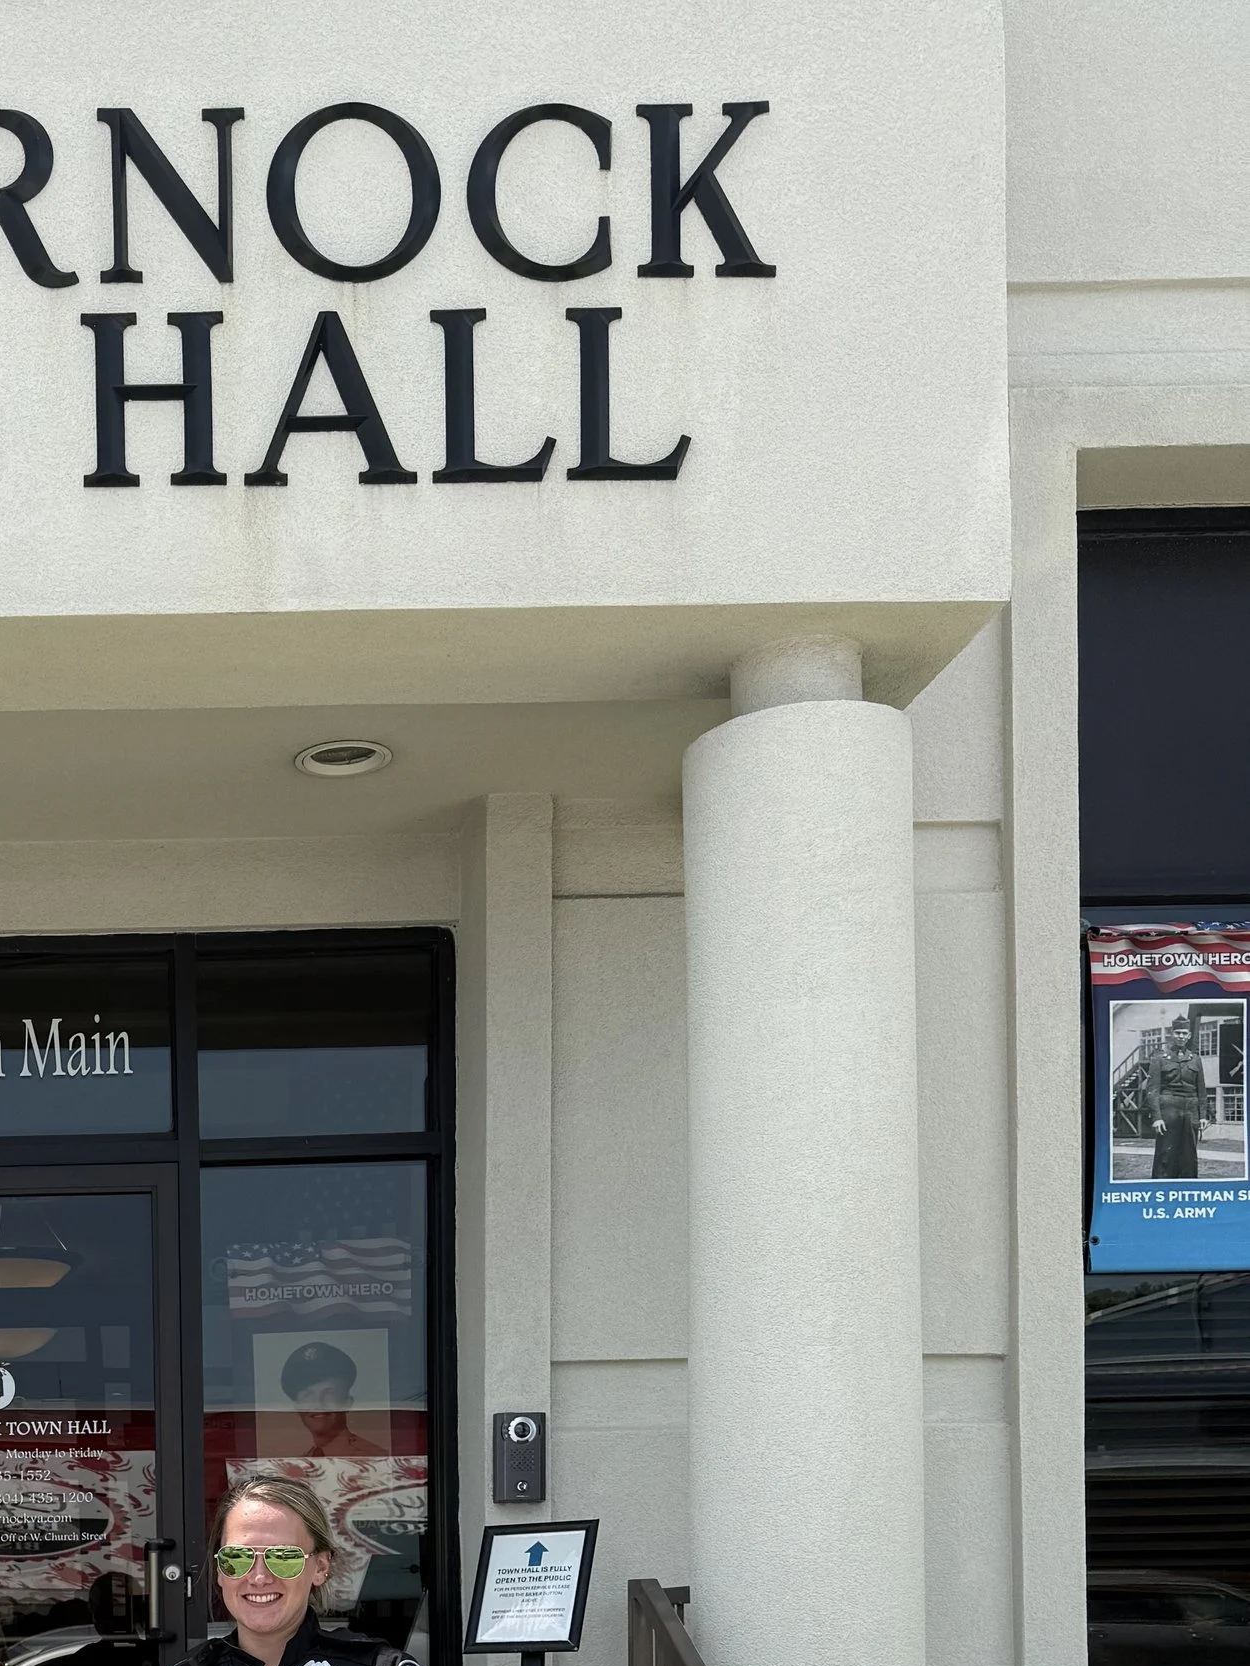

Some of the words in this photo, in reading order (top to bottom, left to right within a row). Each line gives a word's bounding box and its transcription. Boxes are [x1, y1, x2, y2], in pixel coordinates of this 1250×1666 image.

[82, 307, 692, 489] HALL
[1103, 953, 1204, 967] HOMETOWN
[19, 1014, 134, 1080] Main
[1102, 1190, 1152, 1204] HENRY
[1156, 1190, 1165, 1203] S
[1168, 1190, 1235, 1203] PITTMAN
[1237, 1190, 1250, 1202] S
[1142, 1207, 1170, 1220] U.S.
[1173, 1207, 1217, 1220] ARMY
[244, 1283, 344, 1303] HOMETOWN
[348, 1282, 395, 1299] HERO
[5, 1420, 63, 1436] TOWN
[67, 1419, 112, 1435] HALL
[6, 1448, 51, 1462] Monday
[54, 1448, 66, 1458] to
[68, 1447, 104, 1460] Friday
[28, 1491, 94, 1505] 435-1200
[0, 1532, 17, 1543] Off
[17, 1532, 29, 1543] of
[30, 1532, 43, 1542] W.
[44, 1531, 80, 1542] Church
[81, 1530, 108, 1541] Street
[520, 1566, 540, 1574] HALL
[549, 1565, 573, 1573] FULLY
[543, 1574, 572, 1582] PUBLIC
